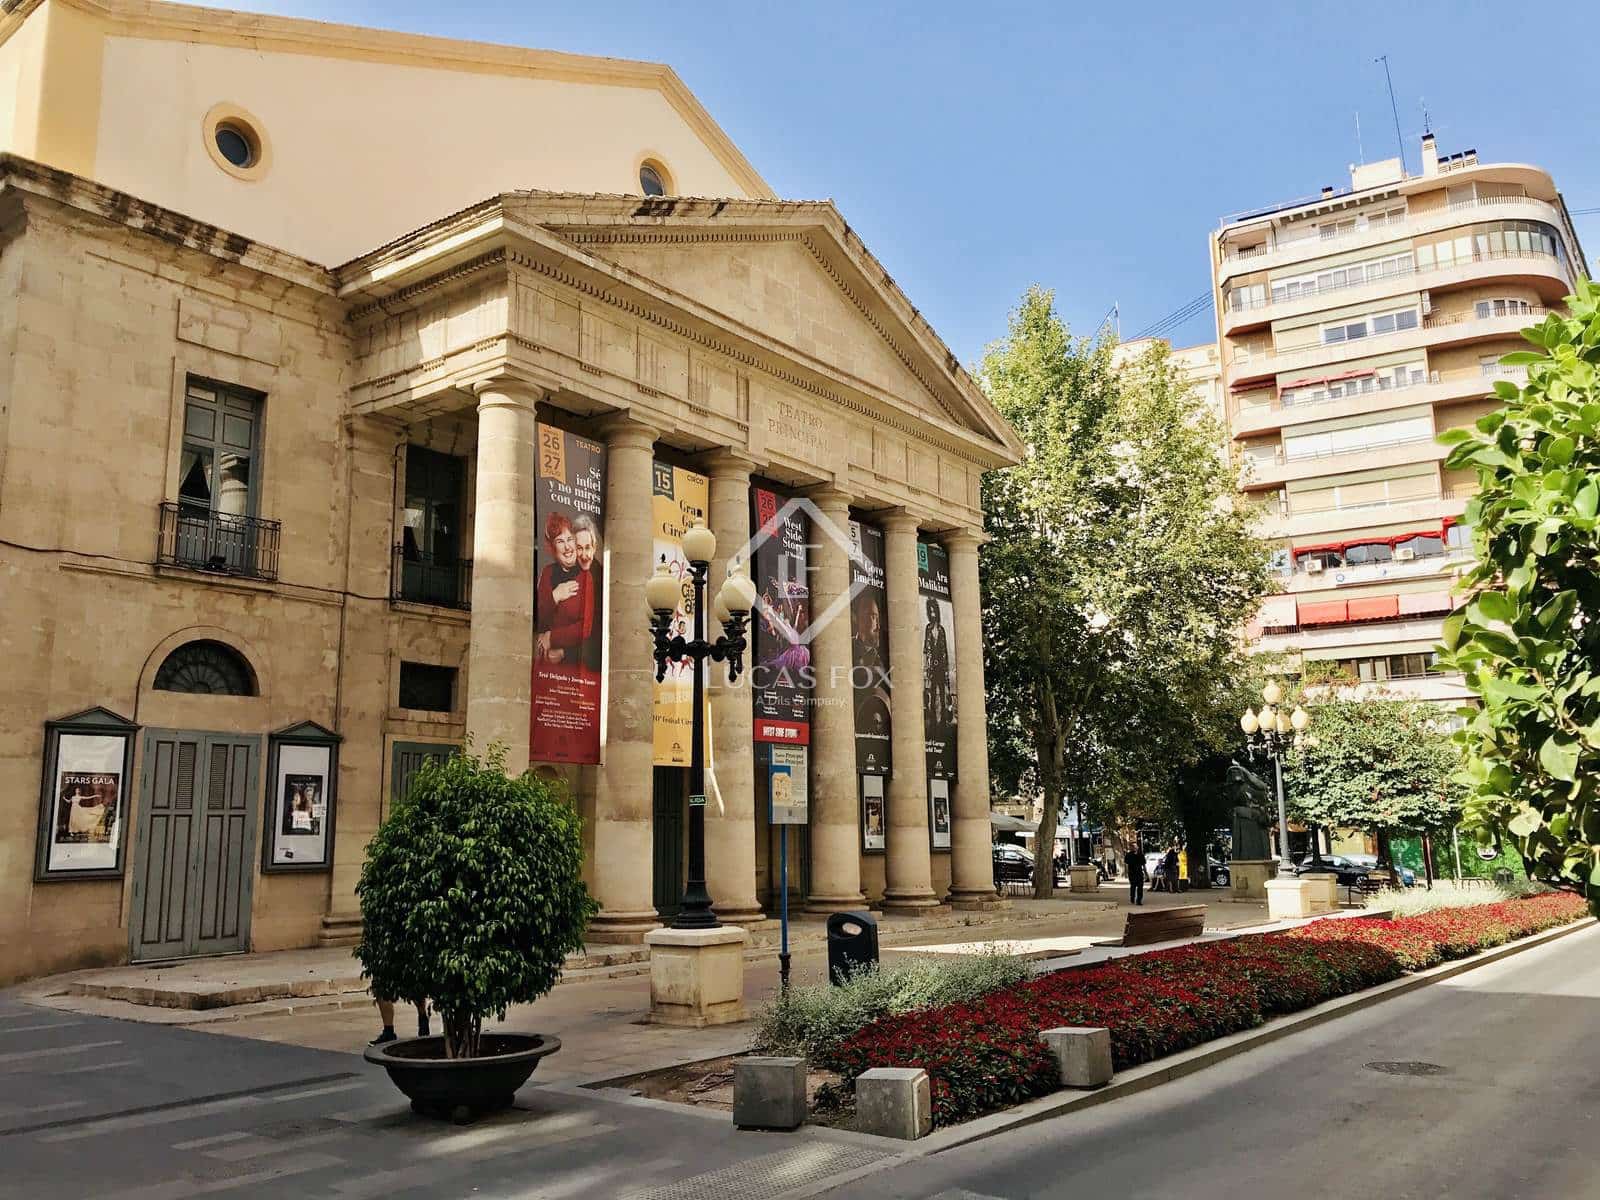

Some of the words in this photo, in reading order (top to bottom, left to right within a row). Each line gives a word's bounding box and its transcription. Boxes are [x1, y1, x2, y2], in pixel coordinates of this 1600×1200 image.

[777, 400, 823, 430] TEATRO
[543, 433, 560, 451] 26
[575, 440, 601, 454] TEATRO
[544, 454, 561, 471] 27
[589, 466, 601, 480] Sé
[655, 470, 671, 490] 15
[548, 480, 556, 493] y
[558, 482, 572, 494] no
[574, 487, 601, 503] mires
[576, 474, 601, 492] infiel
[550, 492, 571, 505] con
[573, 498, 601, 515] quién
[679, 499, 703, 517] Gran
[761, 497, 774, 510] 26
[783, 516, 802, 532] West
[850, 527, 856, 538] 5
[785, 528, 803, 543] Side
[64, 776, 90, 785] STARS
[92, 776, 115, 786] GALA
